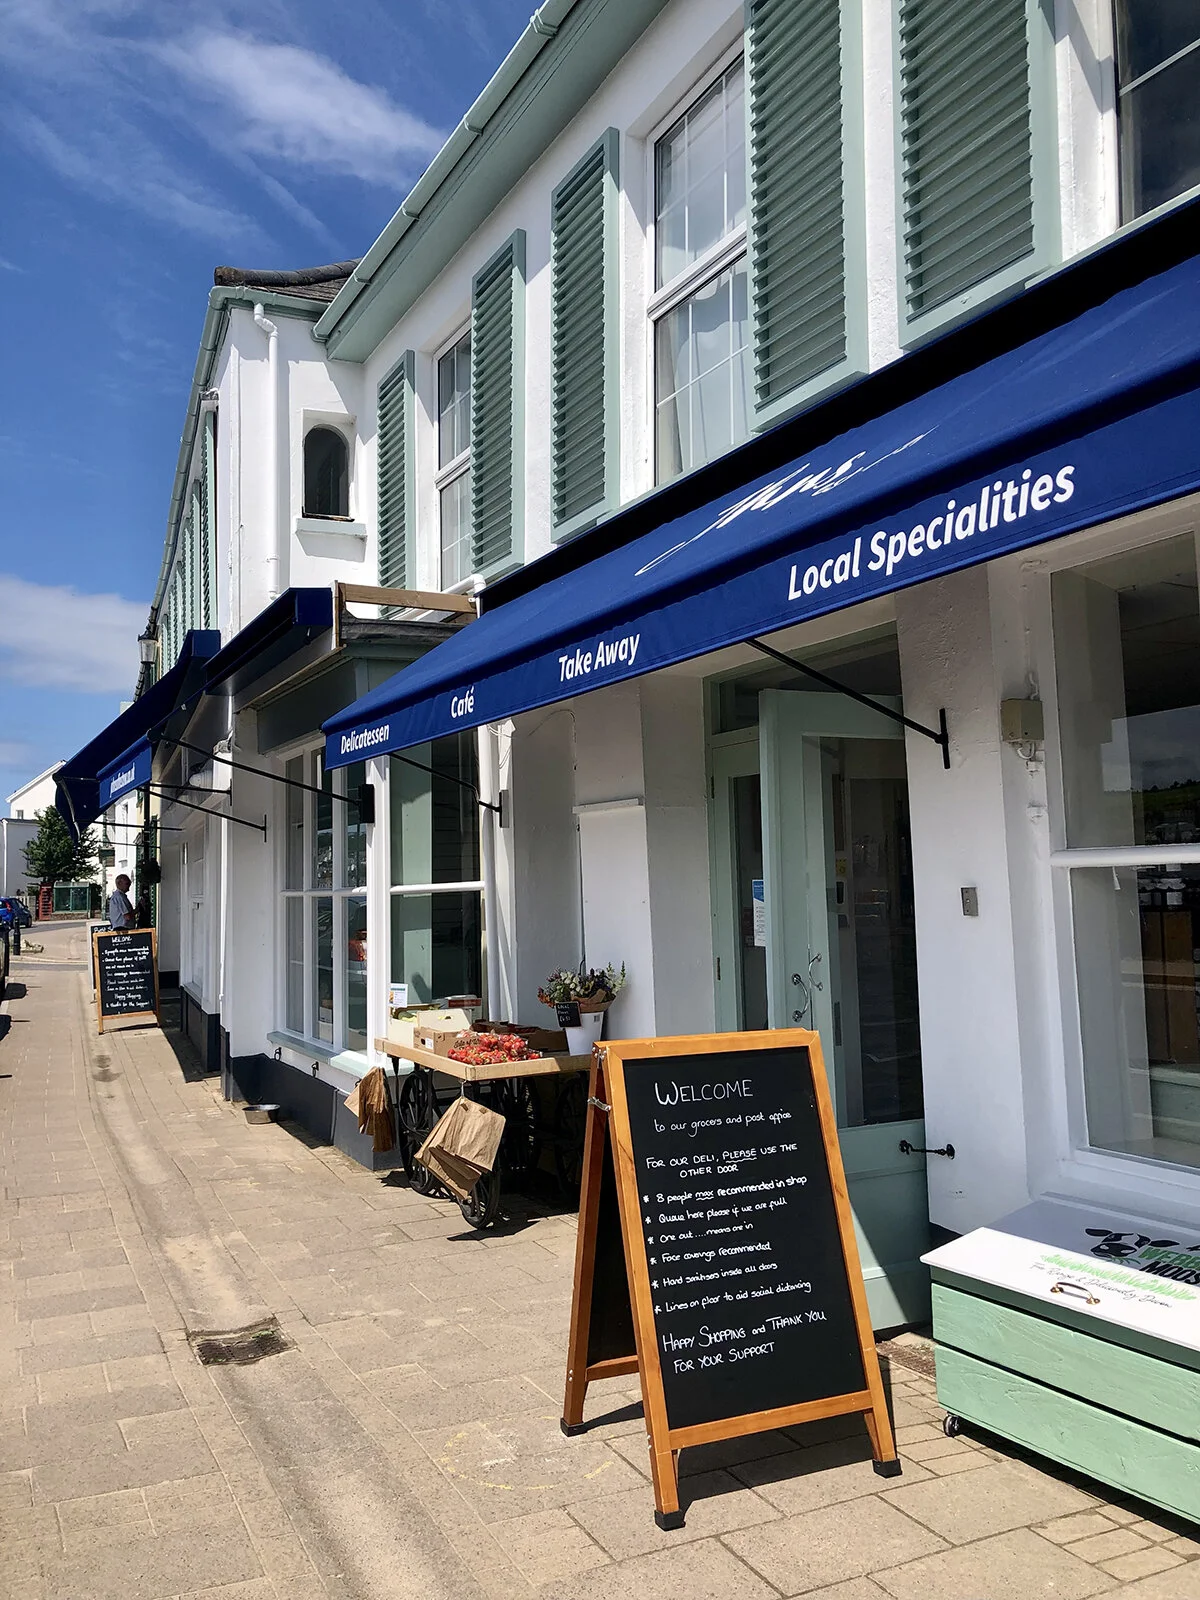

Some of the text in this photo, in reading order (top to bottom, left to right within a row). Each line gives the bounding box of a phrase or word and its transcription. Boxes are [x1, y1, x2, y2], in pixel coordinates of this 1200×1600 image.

[788, 536, 861, 601] Local
[868, 464, 1076, 576] Specialities
[558, 633, 640, 682] Take Away
[451, 685, 475, 719] Café
[340, 723, 390, 755] Delicatessen
[654, 1079, 753, 1105] WELCOME
[654, 1108, 792, 1137] to our grocers and post office
[646, 1143, 798, 1169] FOR OUR DELI, PLEASE USE THE
[680, 1164, 739, 1178] OTHER DOOR
[656, 1176, 807, 1205] 8 people max recommended in shop
[658, 1213, 686, 1223] Queue
[686, 1209, 704, 1219] here
[706, 1208, 730, 1221] please
[732, 1204, 739, 1217] if
[769, 1197, 787, 1211] full
[659, 1234, 676, 1243] One
[743, 1221, 753, 1229] in
[661, 1241, 772, 1263] Face coverings recommended
[663, 1262, 778, 1287] Hand sanitisers inside all doors
[665, 1279, 811, 1312] Lines on floor to aid social distancing
[662, 1332, 695, 1352] HAPPY
[698, 1325, 747, 1348] SHOPPING
[751, 1324, 766, 1335] and
[765, 1313, 803, 1331] THANK
[673, 1342, 775, 1374] FOR YOUR SUPPORT
